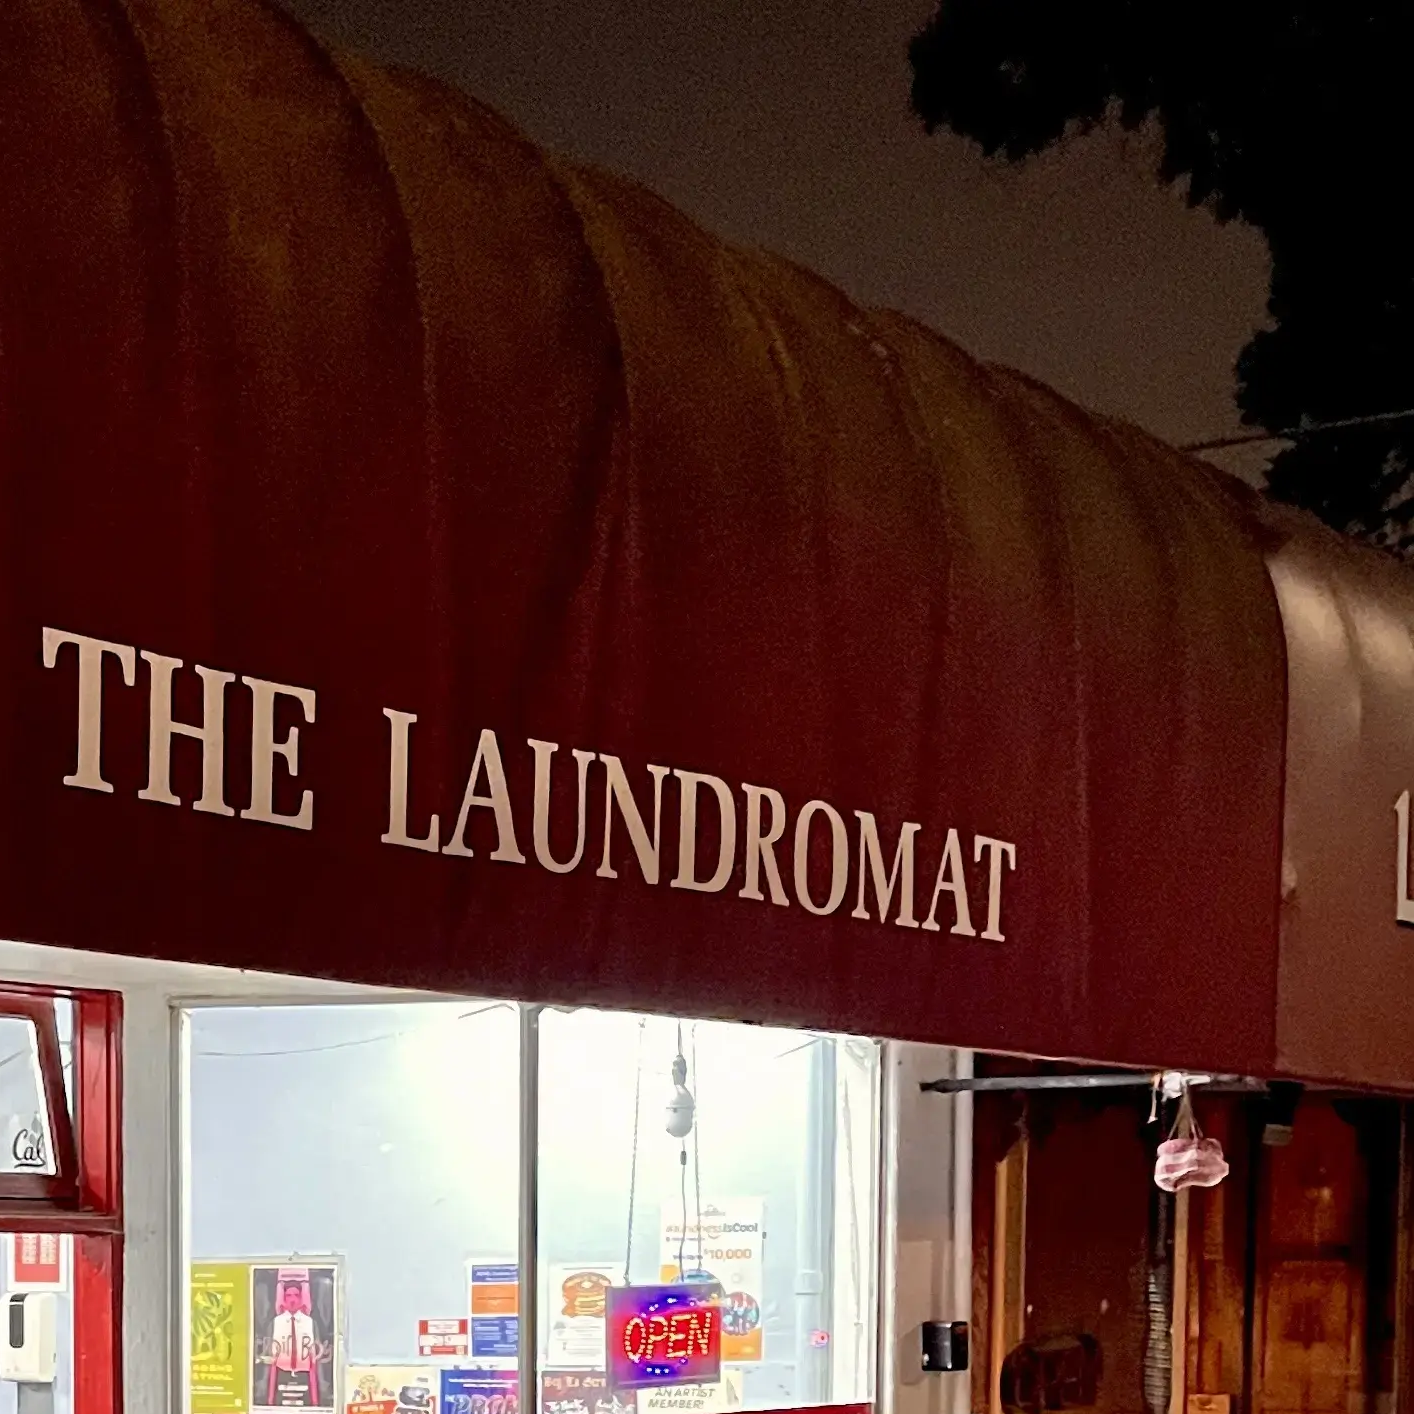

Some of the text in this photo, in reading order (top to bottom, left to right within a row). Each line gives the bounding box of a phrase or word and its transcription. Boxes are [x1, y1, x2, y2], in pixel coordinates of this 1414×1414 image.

[42, 626, 1016, 942] THE LAUNDROMAT
[623, 1312, 712, 1363] OPEN
[648, 1399, 705, 1409] MEMBER!
[674, 1387, 716, 1398] ARTIST
